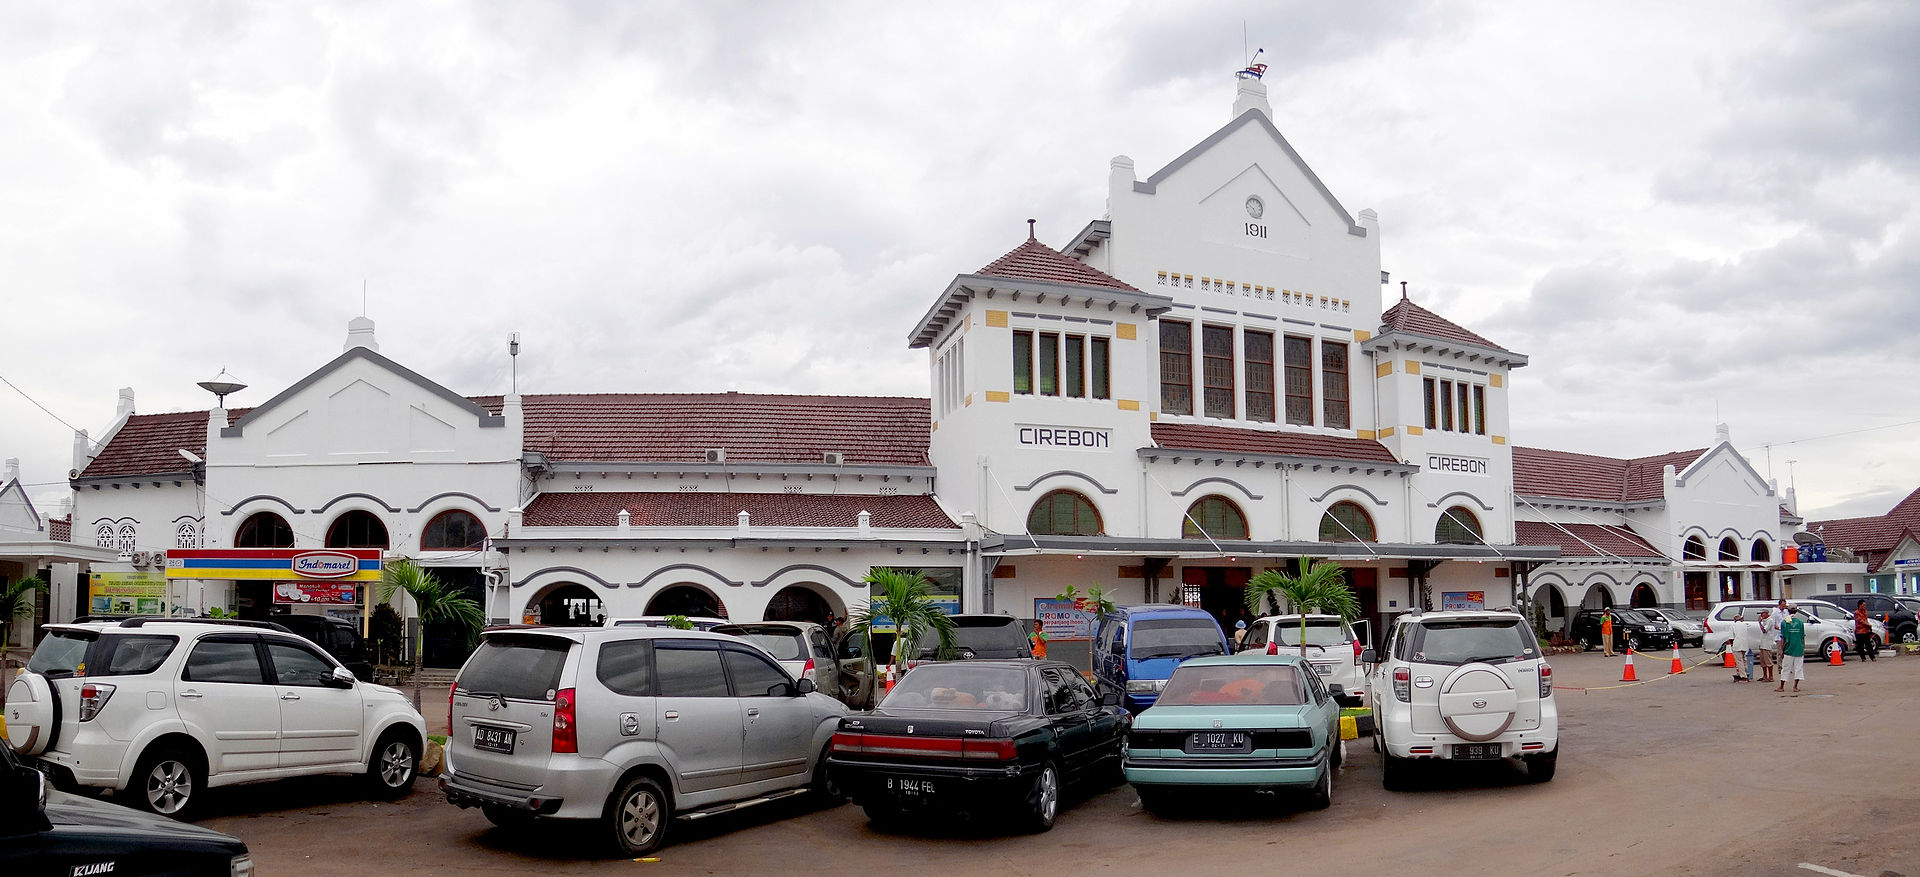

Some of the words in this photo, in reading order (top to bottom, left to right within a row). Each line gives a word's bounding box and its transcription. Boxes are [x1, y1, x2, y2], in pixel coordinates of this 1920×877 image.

[1245, 222, 1267, 239] 1911
[1019, 428, 1108, 448] CIREBON
[1429, 456, 1487, 474] CIREBON
[298, 559, 352, 569] Indomaret
[1039, 612, 1071, 620] PROMO
[476, 729, 484, 740] AD
[487, 731, 502, 743] 8431
[1193, 733, 1199, 743] E
[1207, 733, 1225, 743] 1027
[1233, 733, 1244, 743] KU
[1455, 747, 1459, 755] E
[1469, 746, 1483, 755] 939
[1490, 746, 1499, 755] KU
[887, 778, 893, 789] B
[900, 779, 919, 791] 1944
[74, 861, 115, 877] KIJANG
